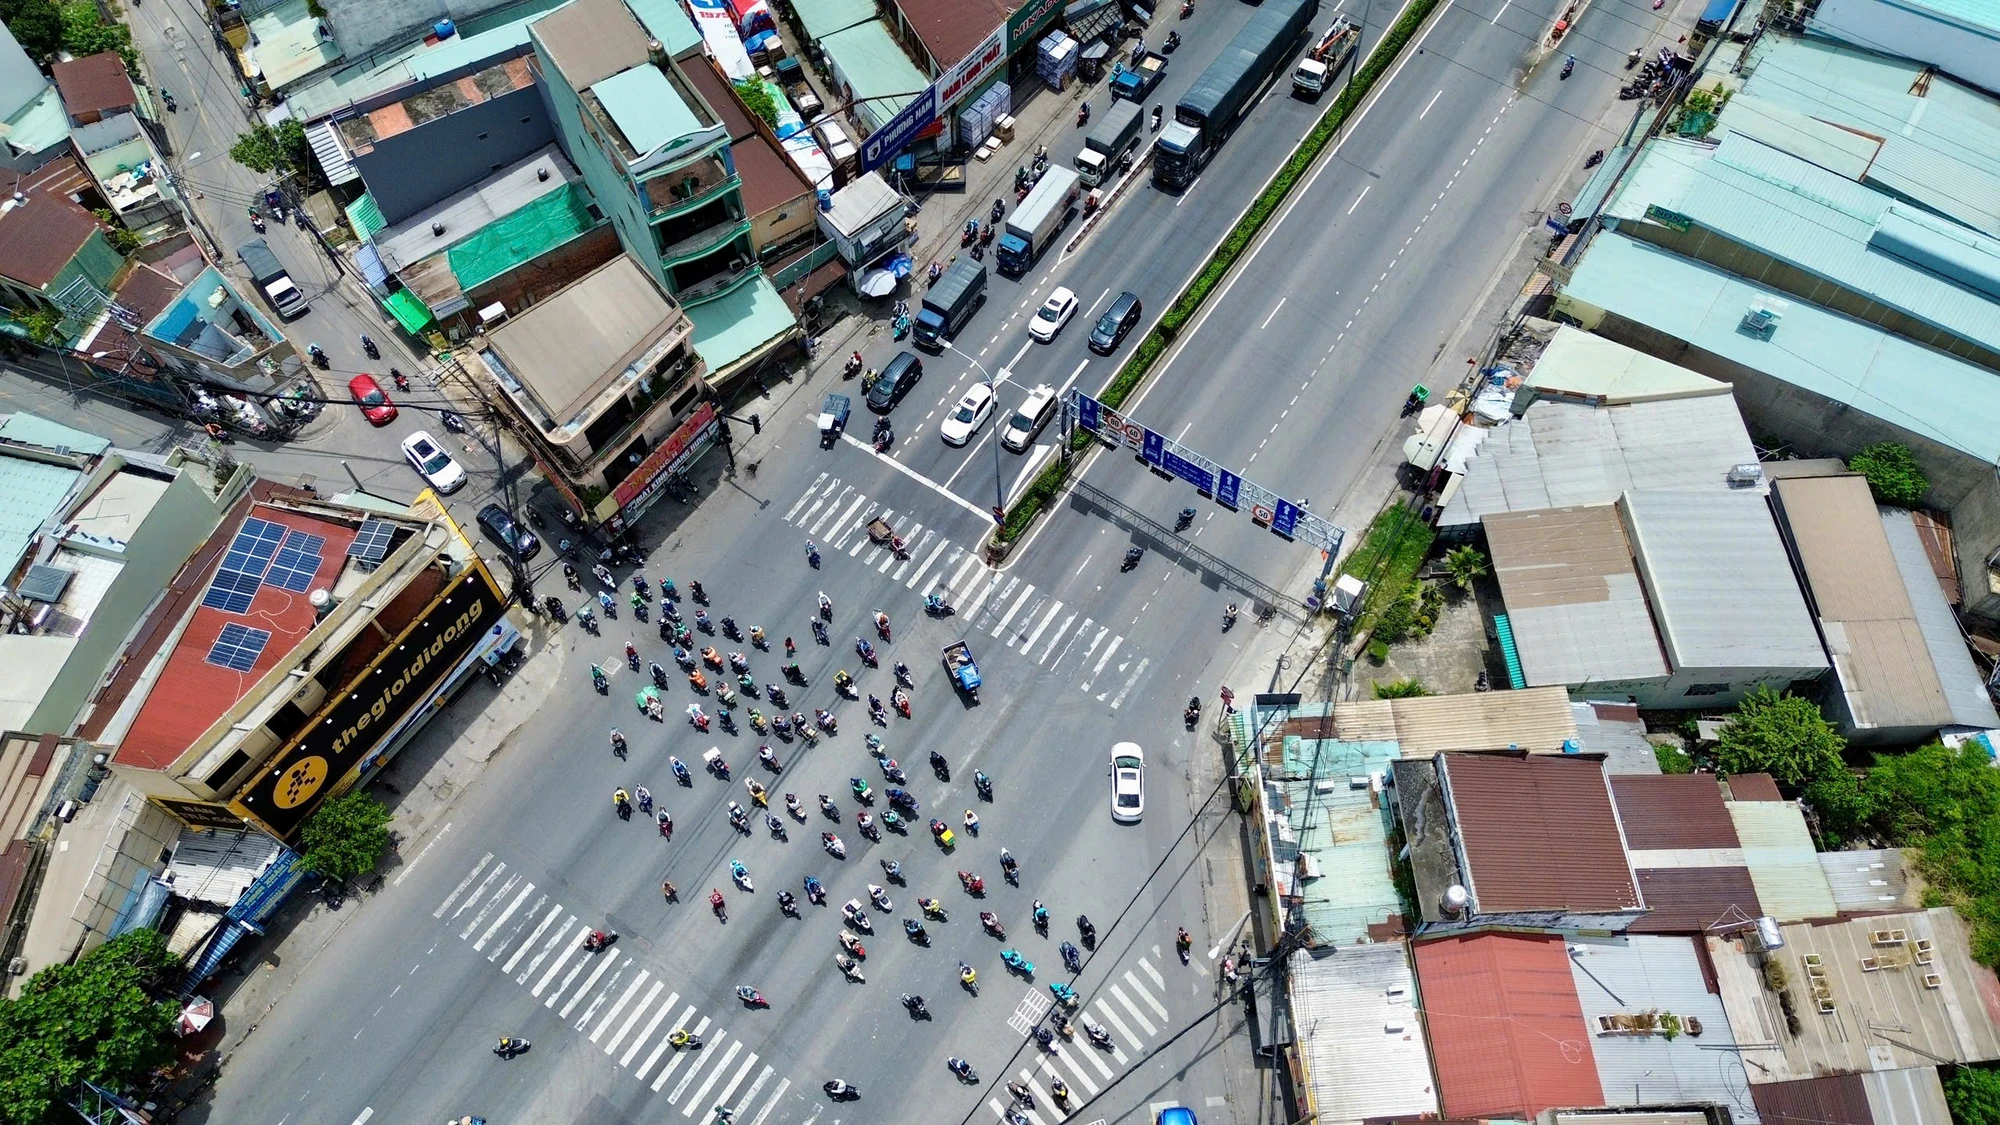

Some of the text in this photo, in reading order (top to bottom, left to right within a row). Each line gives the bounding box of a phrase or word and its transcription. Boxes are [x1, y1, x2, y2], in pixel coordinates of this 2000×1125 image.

[915, 98, 933, 120] NAM
[1110, 418, 1120, 428] 80
[1129, 429, 1139, 438] 60
[1258, 509, 1269, 520] 50
[454, 622, 472, 641] .com
[331, 598, 483, 754] thegioididong
